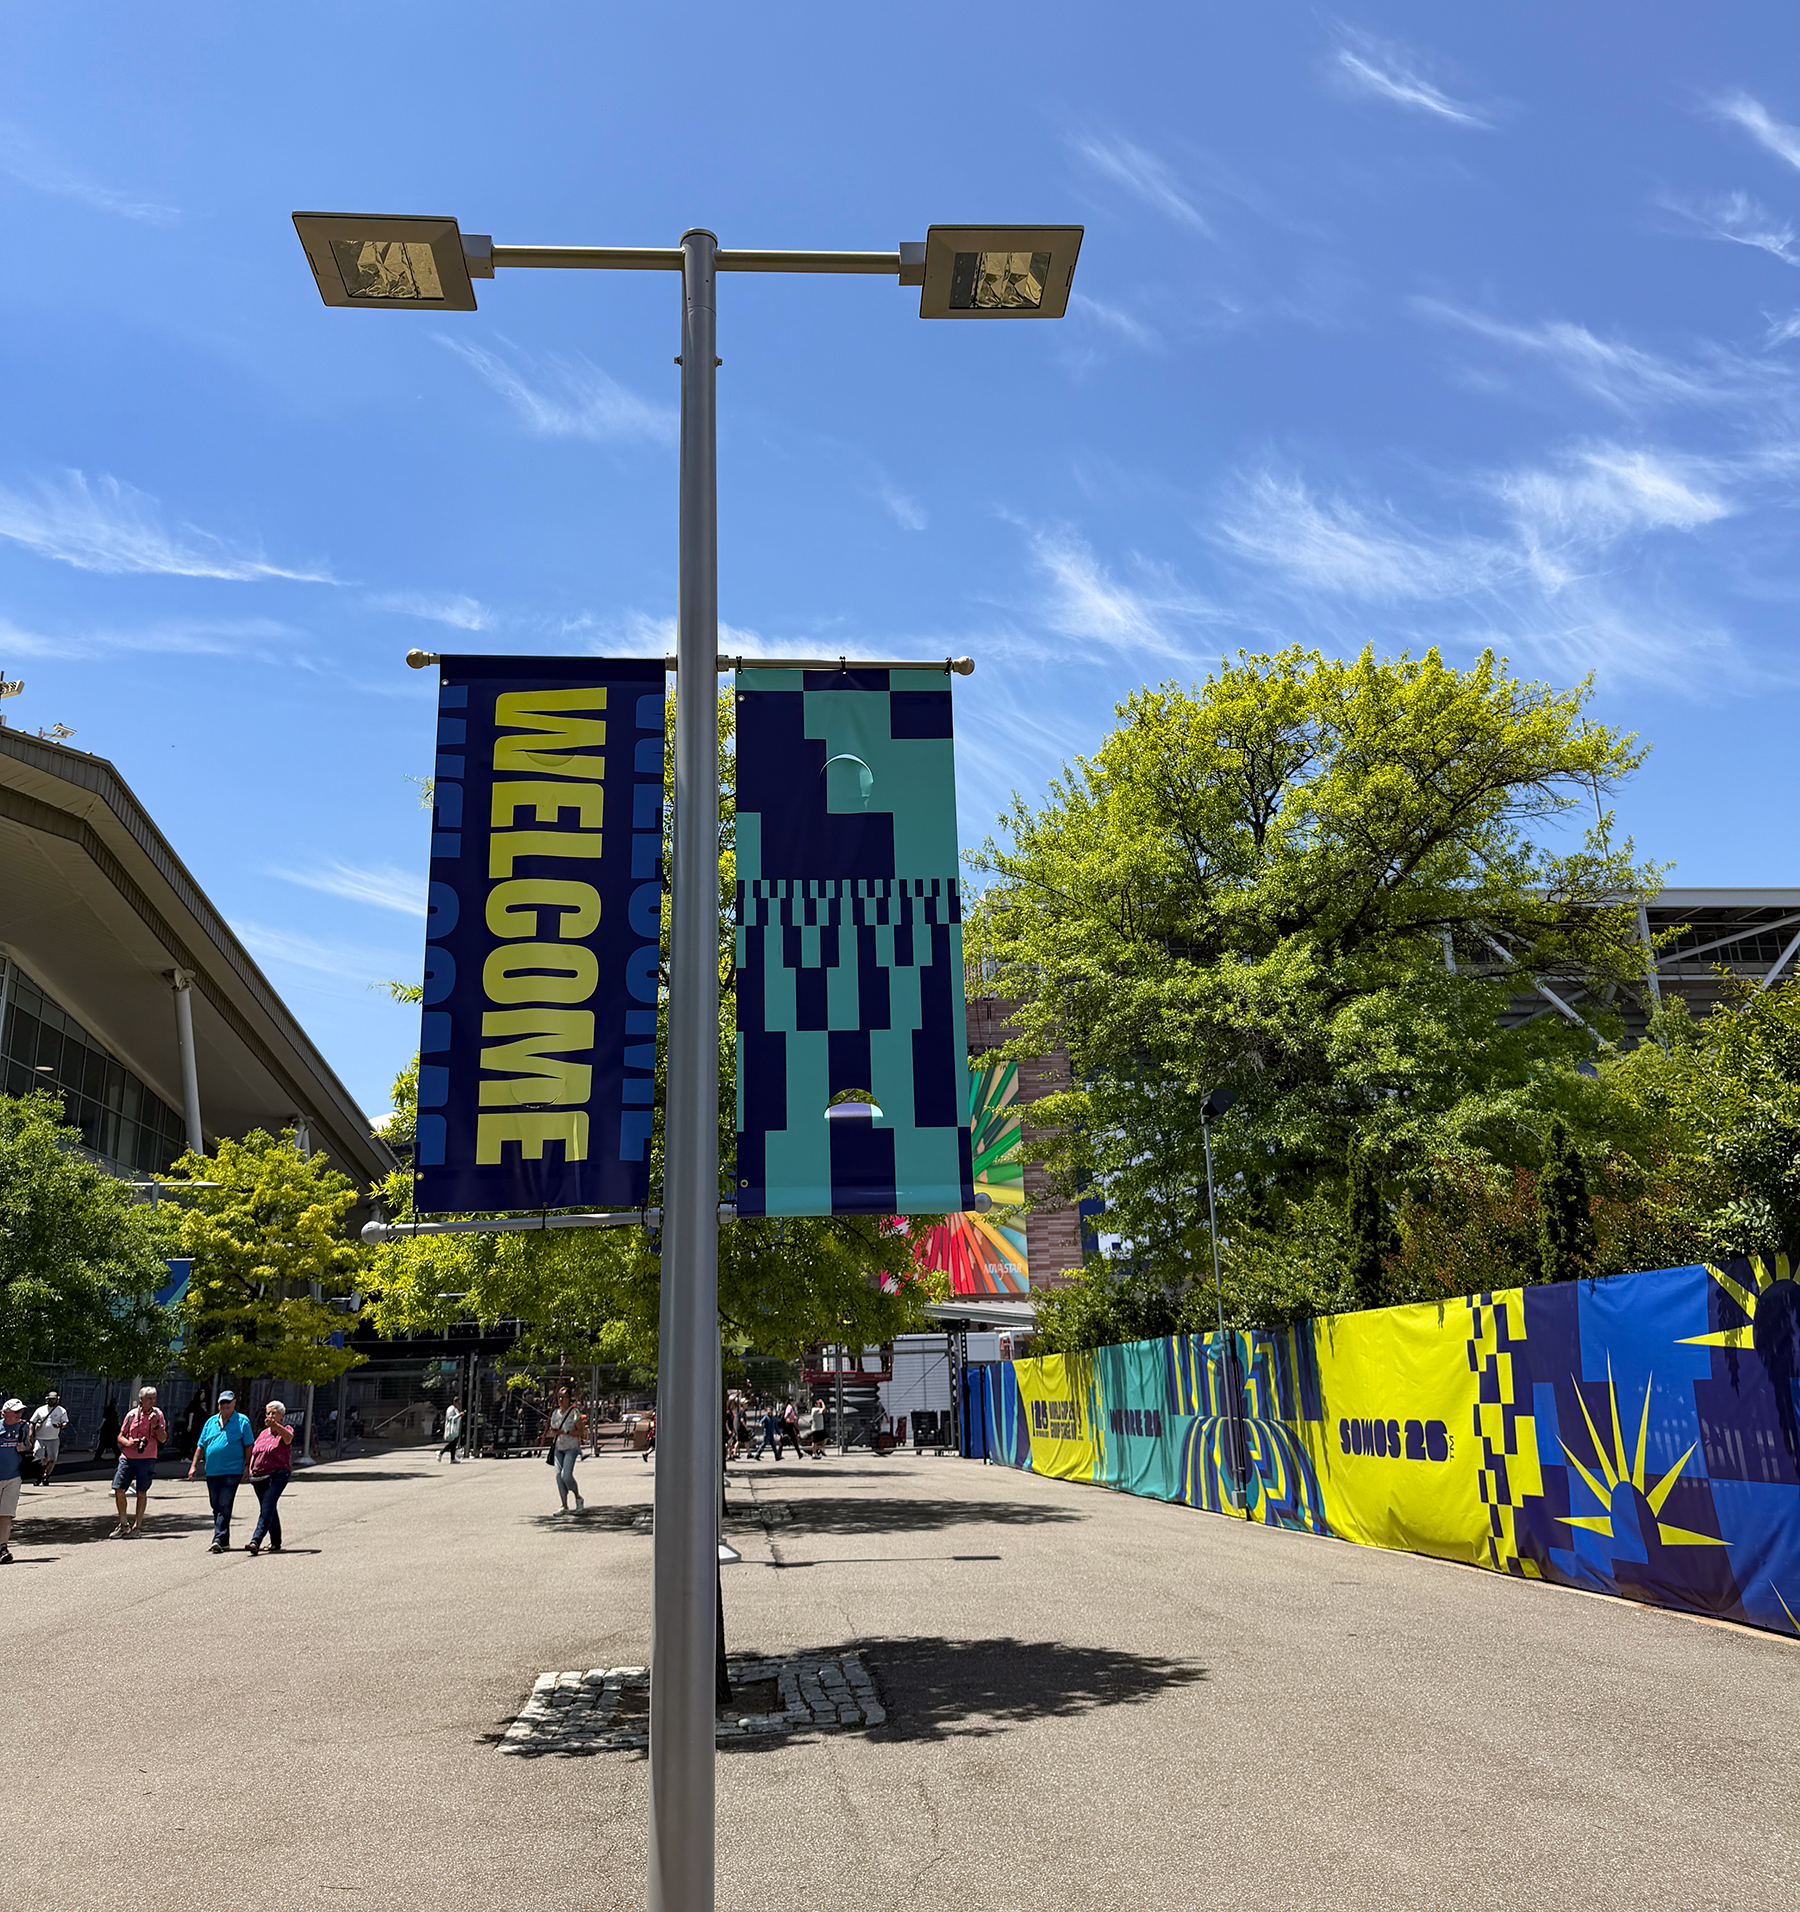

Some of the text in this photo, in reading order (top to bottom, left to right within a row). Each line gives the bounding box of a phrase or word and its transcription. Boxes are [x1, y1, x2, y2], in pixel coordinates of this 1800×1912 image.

[475, 686, 608, 1166] WELCOME
[1339, 1418, 1449, 1462] SOMOS 26
